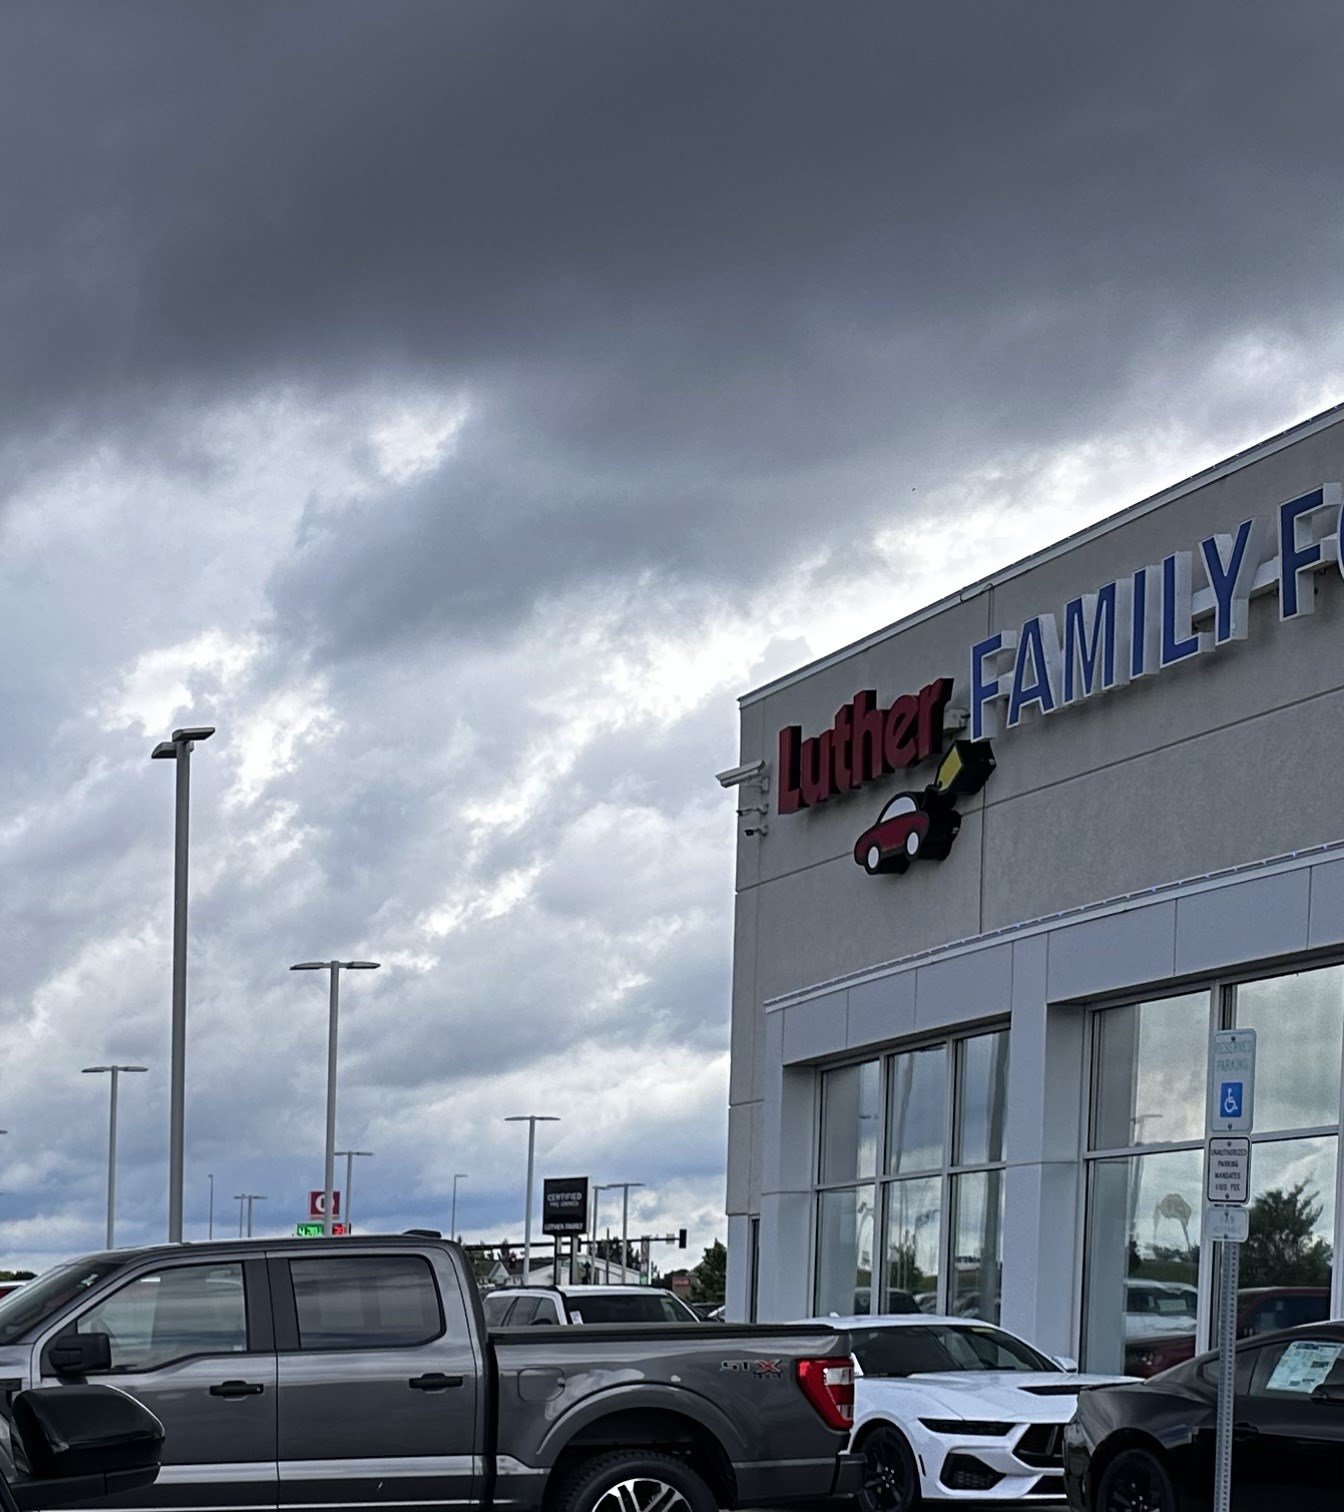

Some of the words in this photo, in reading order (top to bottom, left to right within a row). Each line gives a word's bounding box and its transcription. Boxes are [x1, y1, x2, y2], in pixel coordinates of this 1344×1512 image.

[970, 518, 1260, 742] FAMILY
[1278, 482, 1344, 622] F
[777, 677, 955, 815] Luther
[1216, 1058, 1249, 1072] PARKING
